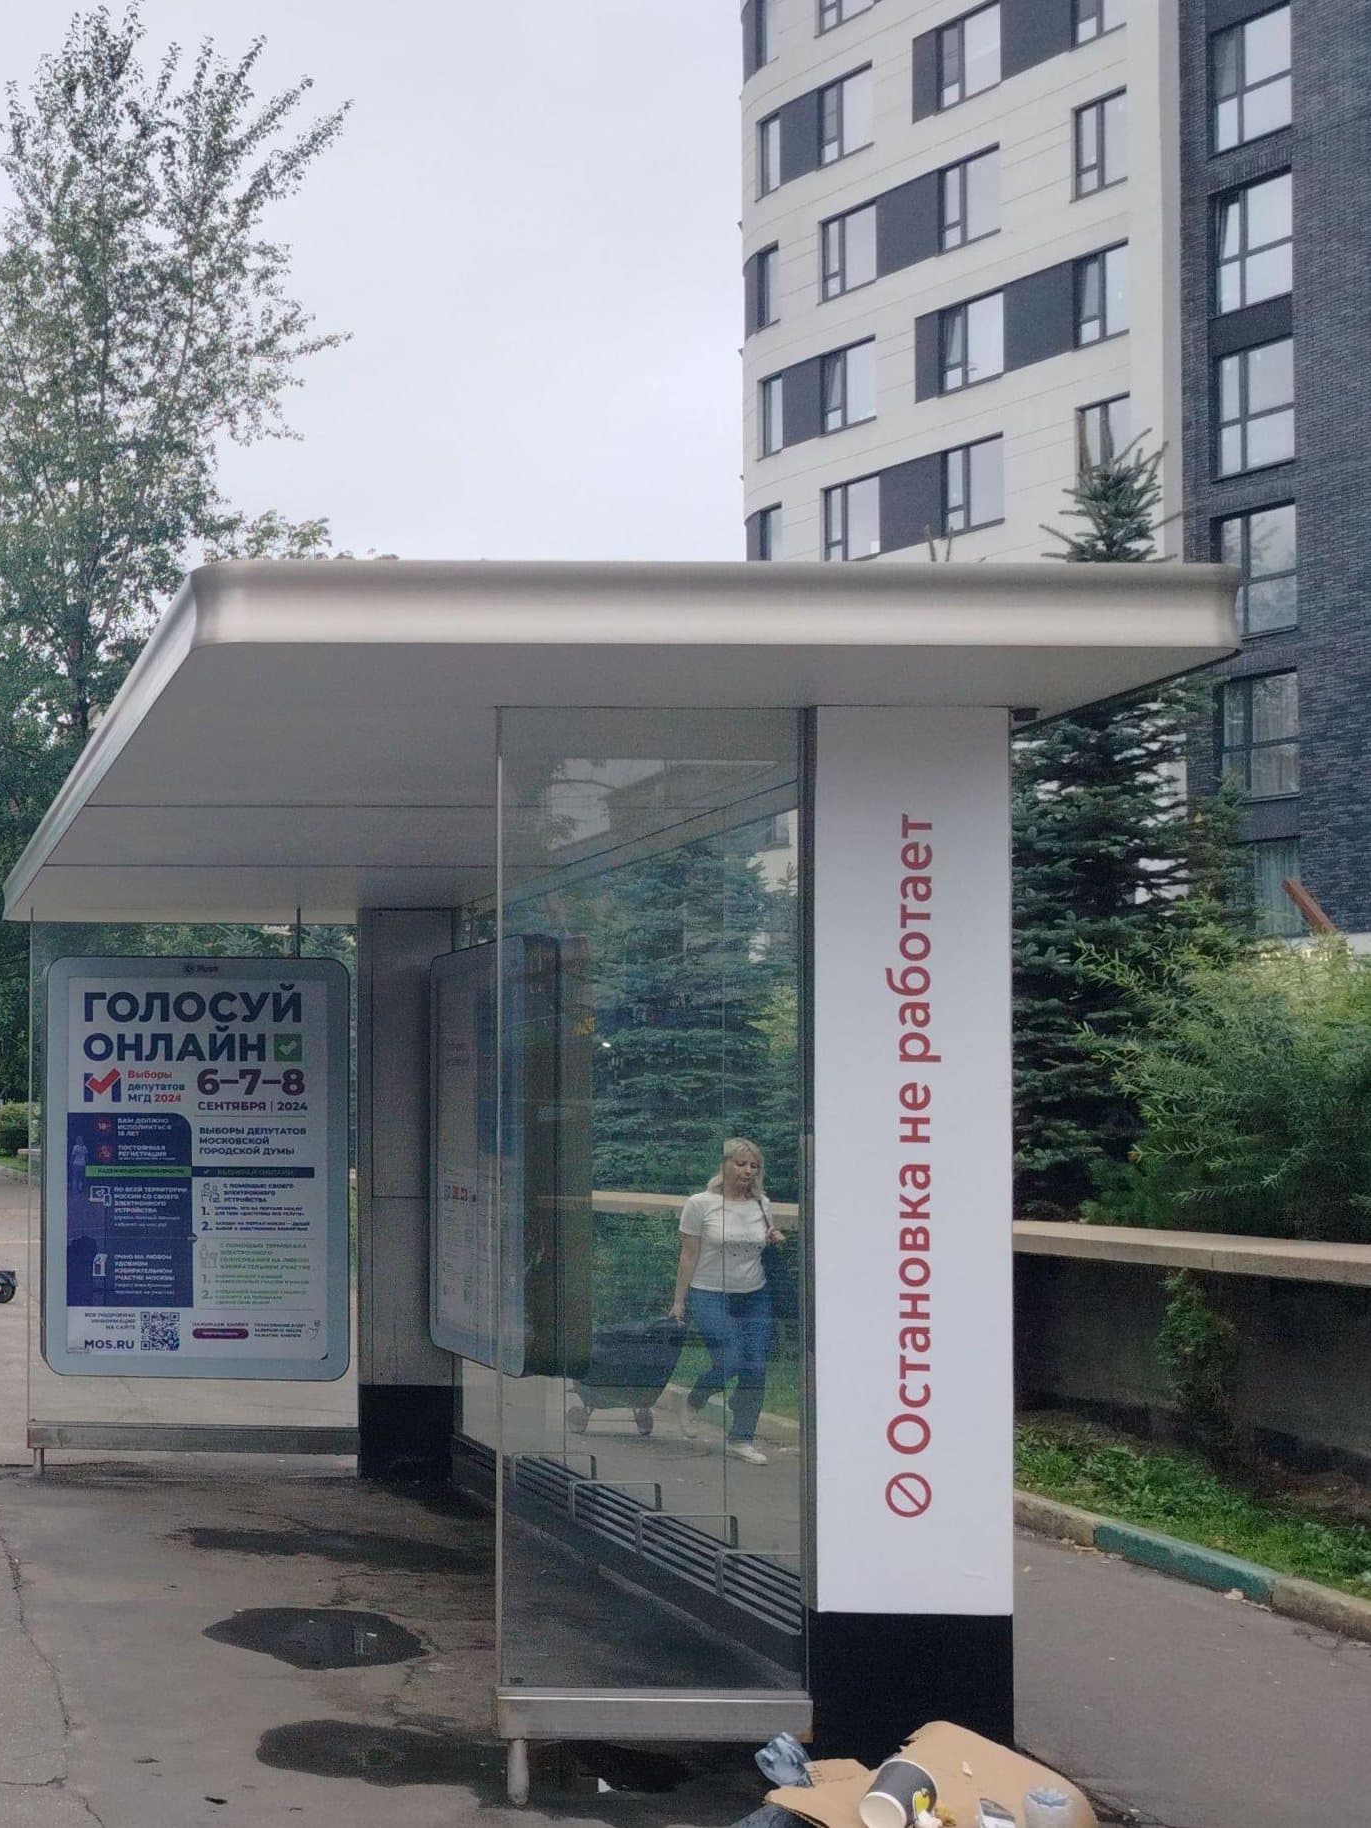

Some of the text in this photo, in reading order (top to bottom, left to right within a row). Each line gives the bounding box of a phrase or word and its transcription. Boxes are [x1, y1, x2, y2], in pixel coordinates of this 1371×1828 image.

[83, 983, 303, 1023] ГОЛОСУЙ
[83, 1025, 266, 1062] ОНЛАЙН
[127, 1069, 173, 1080] Выборы
[127, 1082, 186, 1092] депутатов
[128, 1094, 182, 1103] МГД 2024
[197, 1101, 308, 1111] СЕНТЯБРЯ 2024
[199, 1127, 307, 1136] ВЫБОРЫ ДЕПУТАТОВ
[884, 812, 942, 1456] Остановка не работает
[199, 1136, 270, 1145] МОСКОВСКОЙ
[199, 1145, 295, 1156] ГОРОДСКОЙ ДУМЫ
[84, 1339, 135, 1350] MOS.RU
